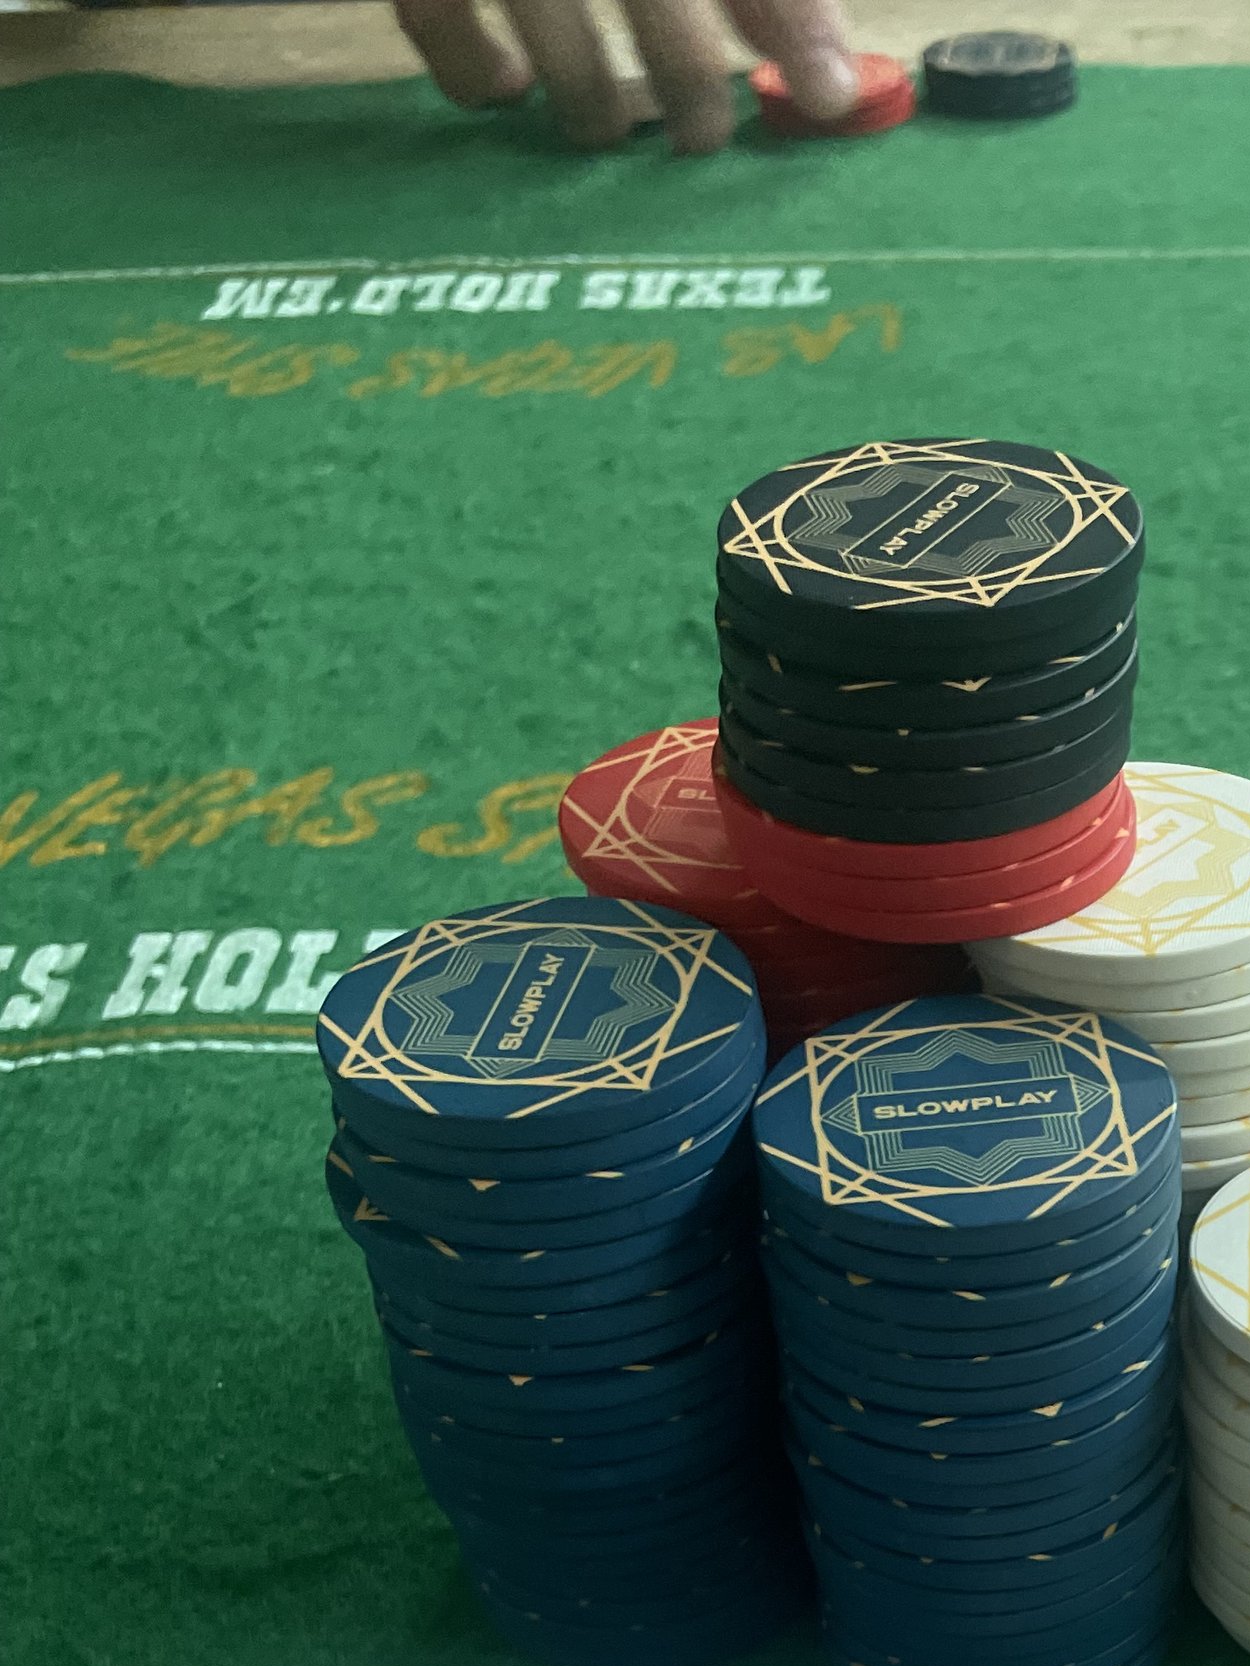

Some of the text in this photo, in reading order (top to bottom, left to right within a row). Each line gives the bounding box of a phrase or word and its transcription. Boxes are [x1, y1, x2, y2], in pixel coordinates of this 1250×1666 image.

[200, 266, 833, 321] TEXAS HOLD'EM
[879, 481, 980, 557] SLOWPLAY
[0, 767, 428, 869] VEGAS
[101, 926, 408, 1022] HOL
[497, 952, 566, 1052] SLOWPLAY
[873, 1088, 1059, 1121] SLOWPLAY
